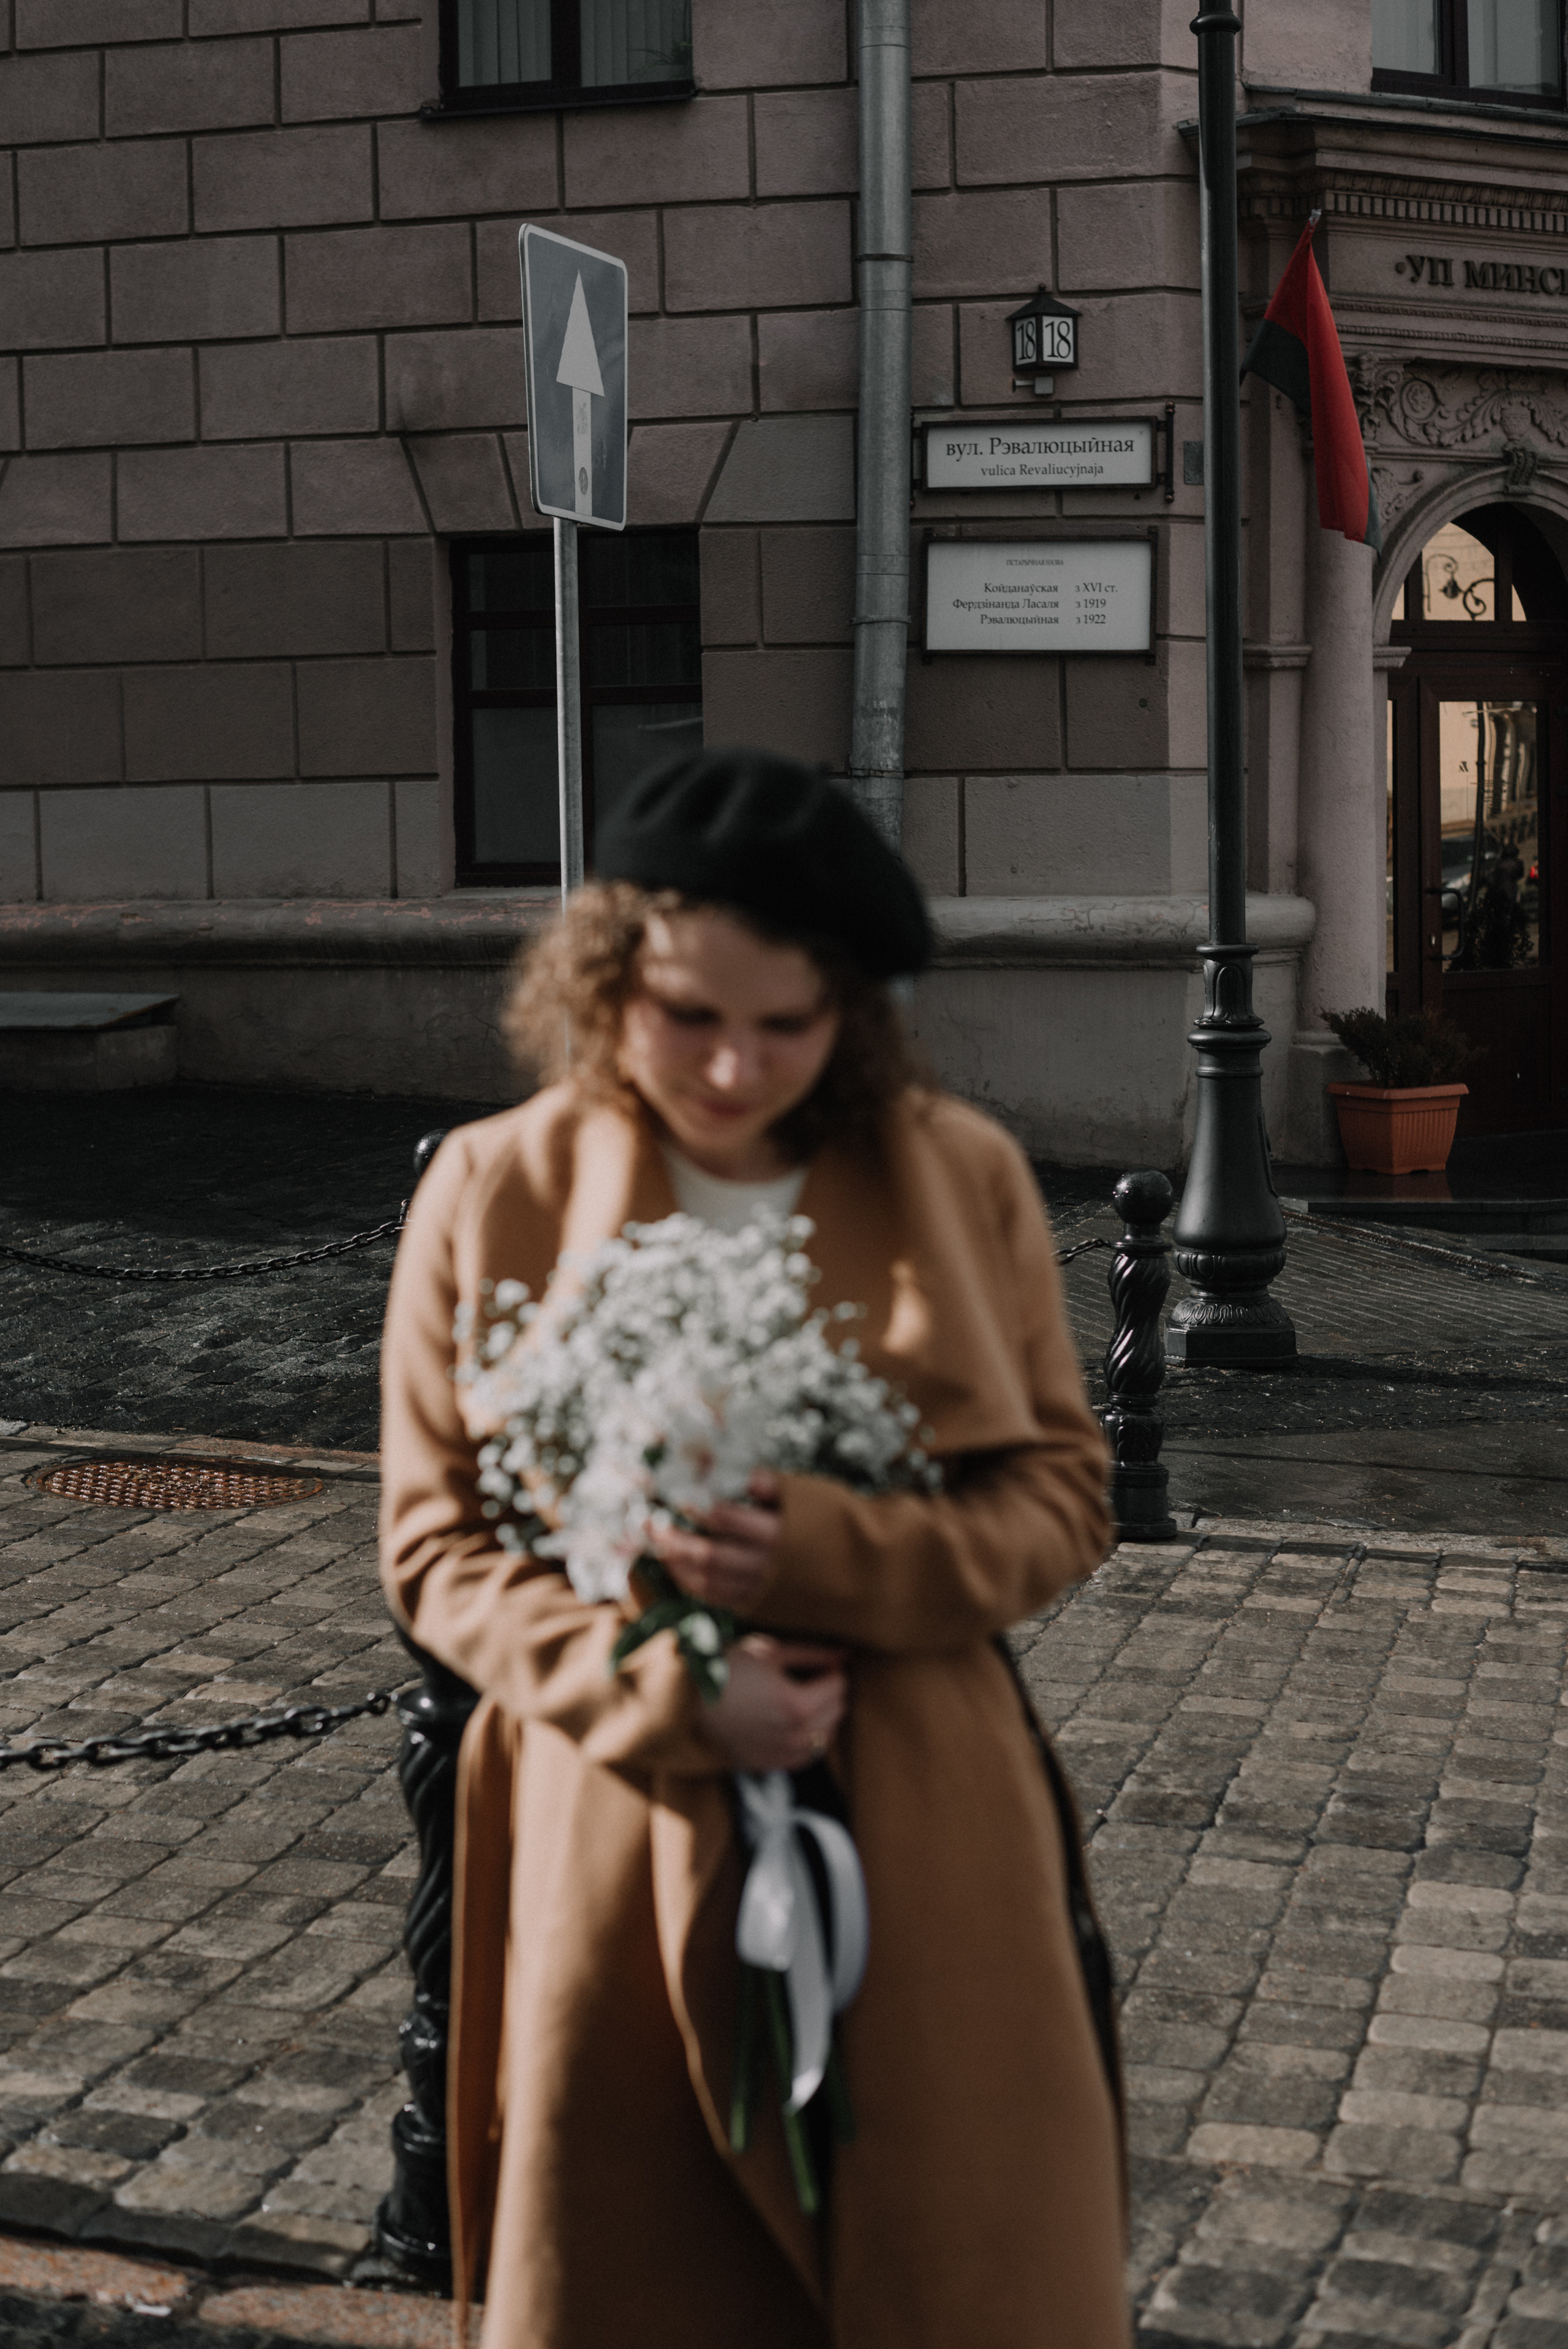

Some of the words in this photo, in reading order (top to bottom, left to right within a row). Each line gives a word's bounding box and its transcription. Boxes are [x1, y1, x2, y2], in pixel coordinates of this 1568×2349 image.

[1405, 255, 1455, 286] УП
[1017, 321, 1035, 360] 18
[1045, 321, 1071, 359] 18
[946, 443, 983, 462] вул.
[989, 437, 1134, 456] Рэвалюцыйная
[981, 464, 1016, 476] vulica
[1019, 463, 1104, 478] Revaliucyjnaja
[984, 583, 1058, 596] Койданаўская
[1083, 583, 1102, 593] XVI
[1104, 584, 1118, 593] ст.
[952, 598, 1020, 611] Фердзінанда
[1022, 598, 1059, 609] Ласаля
[1084, 598, 1106, 609] 1919
[980, 614, 1059, 625] Рэвалюцыйная
[1084, 614, 1106, 624] 1922
